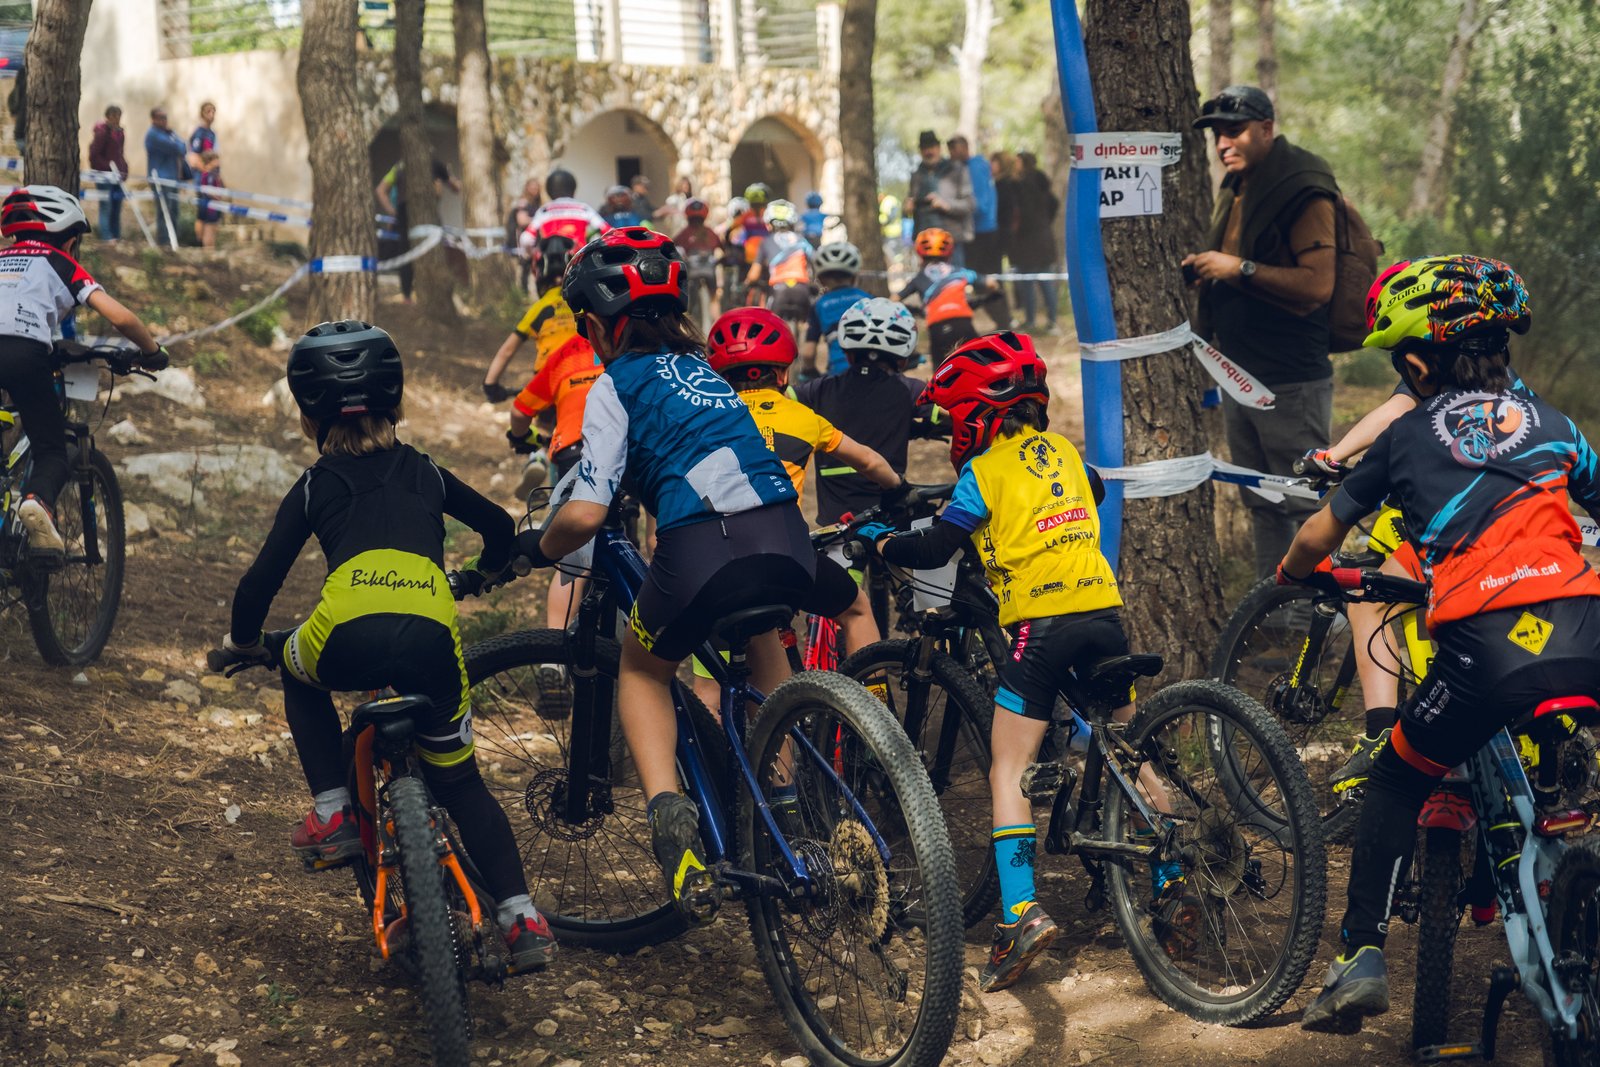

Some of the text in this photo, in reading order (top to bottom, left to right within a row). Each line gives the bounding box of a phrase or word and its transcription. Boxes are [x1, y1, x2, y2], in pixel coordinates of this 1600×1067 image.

[1094, 143, 1137, 159] equip
[1140, 144, 1158, 156] un
[1397, 283, 1426, 301] GIRO
[1206, 346, 1254, 393] un equip
[677, 387, 726, 409] MÓRA
[1044, 538, 1059, 550] LA
[350, 569, 437, 597] BikeGarraf
[1479, 562, 1562, 591] riberabike.cat
